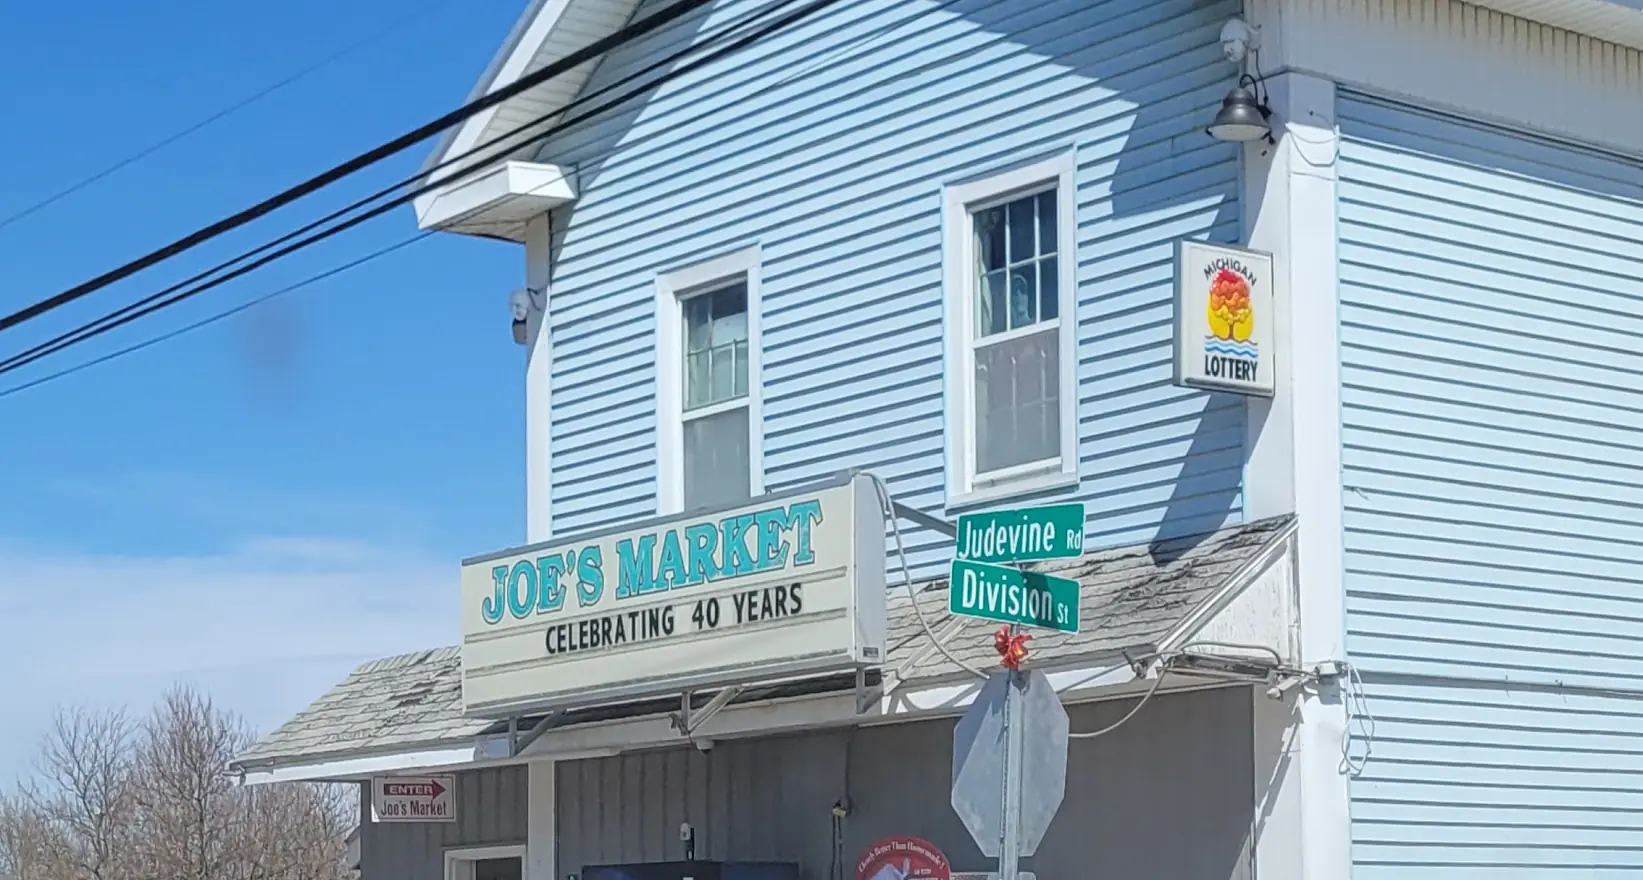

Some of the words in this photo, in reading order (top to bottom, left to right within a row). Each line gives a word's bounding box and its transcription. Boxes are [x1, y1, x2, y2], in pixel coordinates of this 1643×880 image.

[1203, 257, 1257, 287] MICHIGAN
[1204, 354, 1258, 382] LOTTERY
[958, 515, 1055, 559] Judevine
[1066, 529, 1082, 550] Rd
[482, 544, 604, 625] JOE'S
[615, 500, 823, 600] MARKET
[962, 568, 1052, 621] Division
[1057, 602, 1069, 624] St
[545, 605, 674, 655] CELEBRATING
[691, 599, 720, 631] 40
[733, 583, 803, 624] YEARS
[389, 785, 434, 795] ENTER
[410, 800, 447, 816] Market
